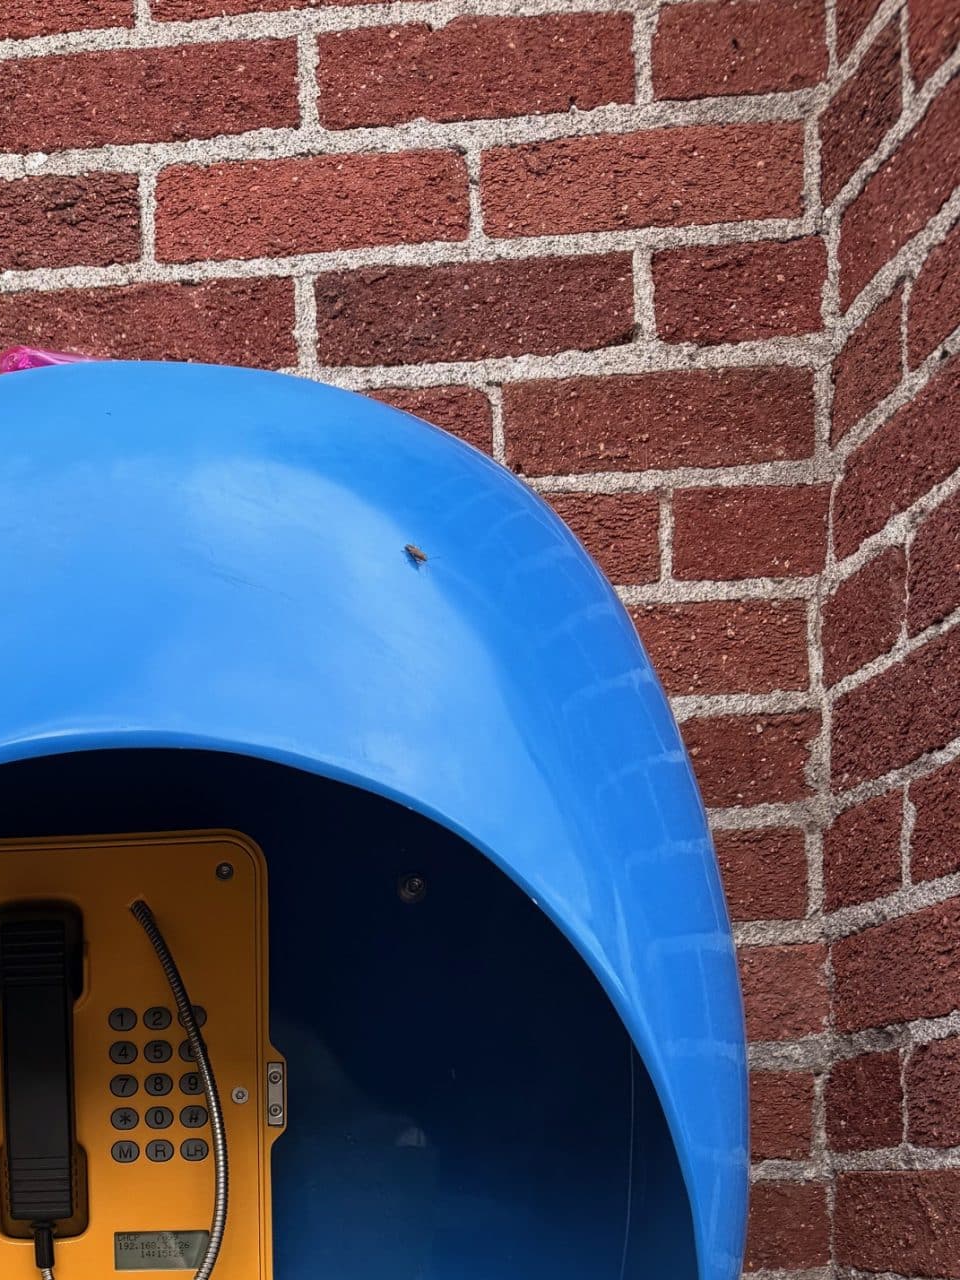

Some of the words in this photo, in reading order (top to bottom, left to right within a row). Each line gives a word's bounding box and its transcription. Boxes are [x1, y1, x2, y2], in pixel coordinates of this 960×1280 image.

[117, 1013, 125, 1027] 1
[152, 1012, 162, 1025] 2
[118, 1046, 128, 1059] 4
[153, 1045, 163, 1059] 5
[119, 1078, 129, 1093] 7
[154, 1077, 163, 1092] 8
[188, 1076, 198, 1090] 9
[154, 1110, 164, 1124] 0
[188, 1110, 198, 1123] #
[119, 1146, 132, 1158] M
[155, 1144, 166, 1158] R
[187, 1144, 204, 1156] LR
